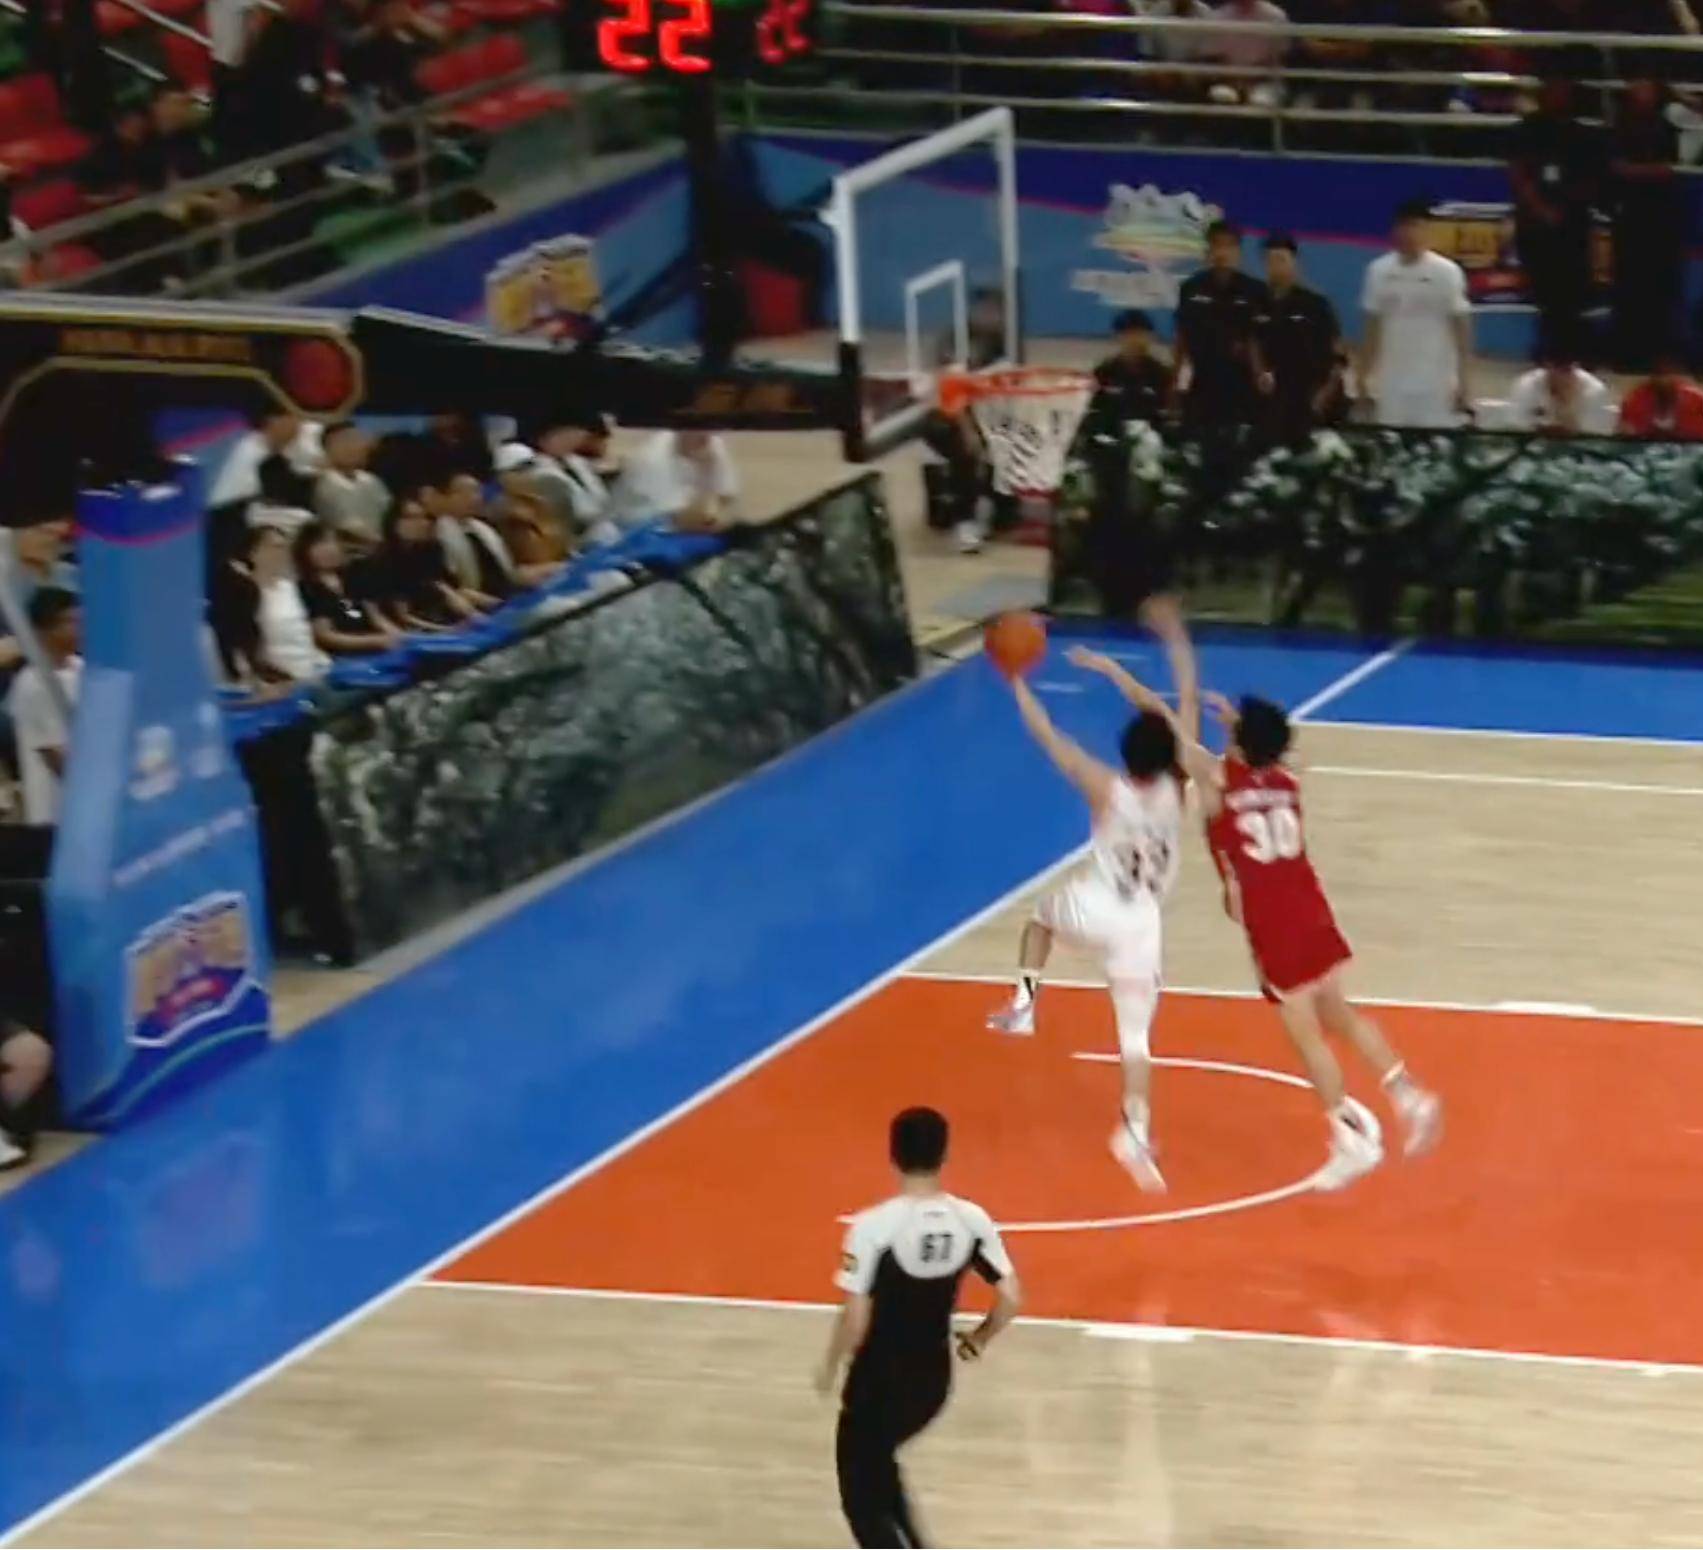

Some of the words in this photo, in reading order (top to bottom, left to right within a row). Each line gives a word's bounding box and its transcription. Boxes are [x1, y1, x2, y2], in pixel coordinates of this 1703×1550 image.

[597, 0, 711, 75] 22
[1234, 807, 1301, 864] 30
[920, 1232, 953, 1263] 67
